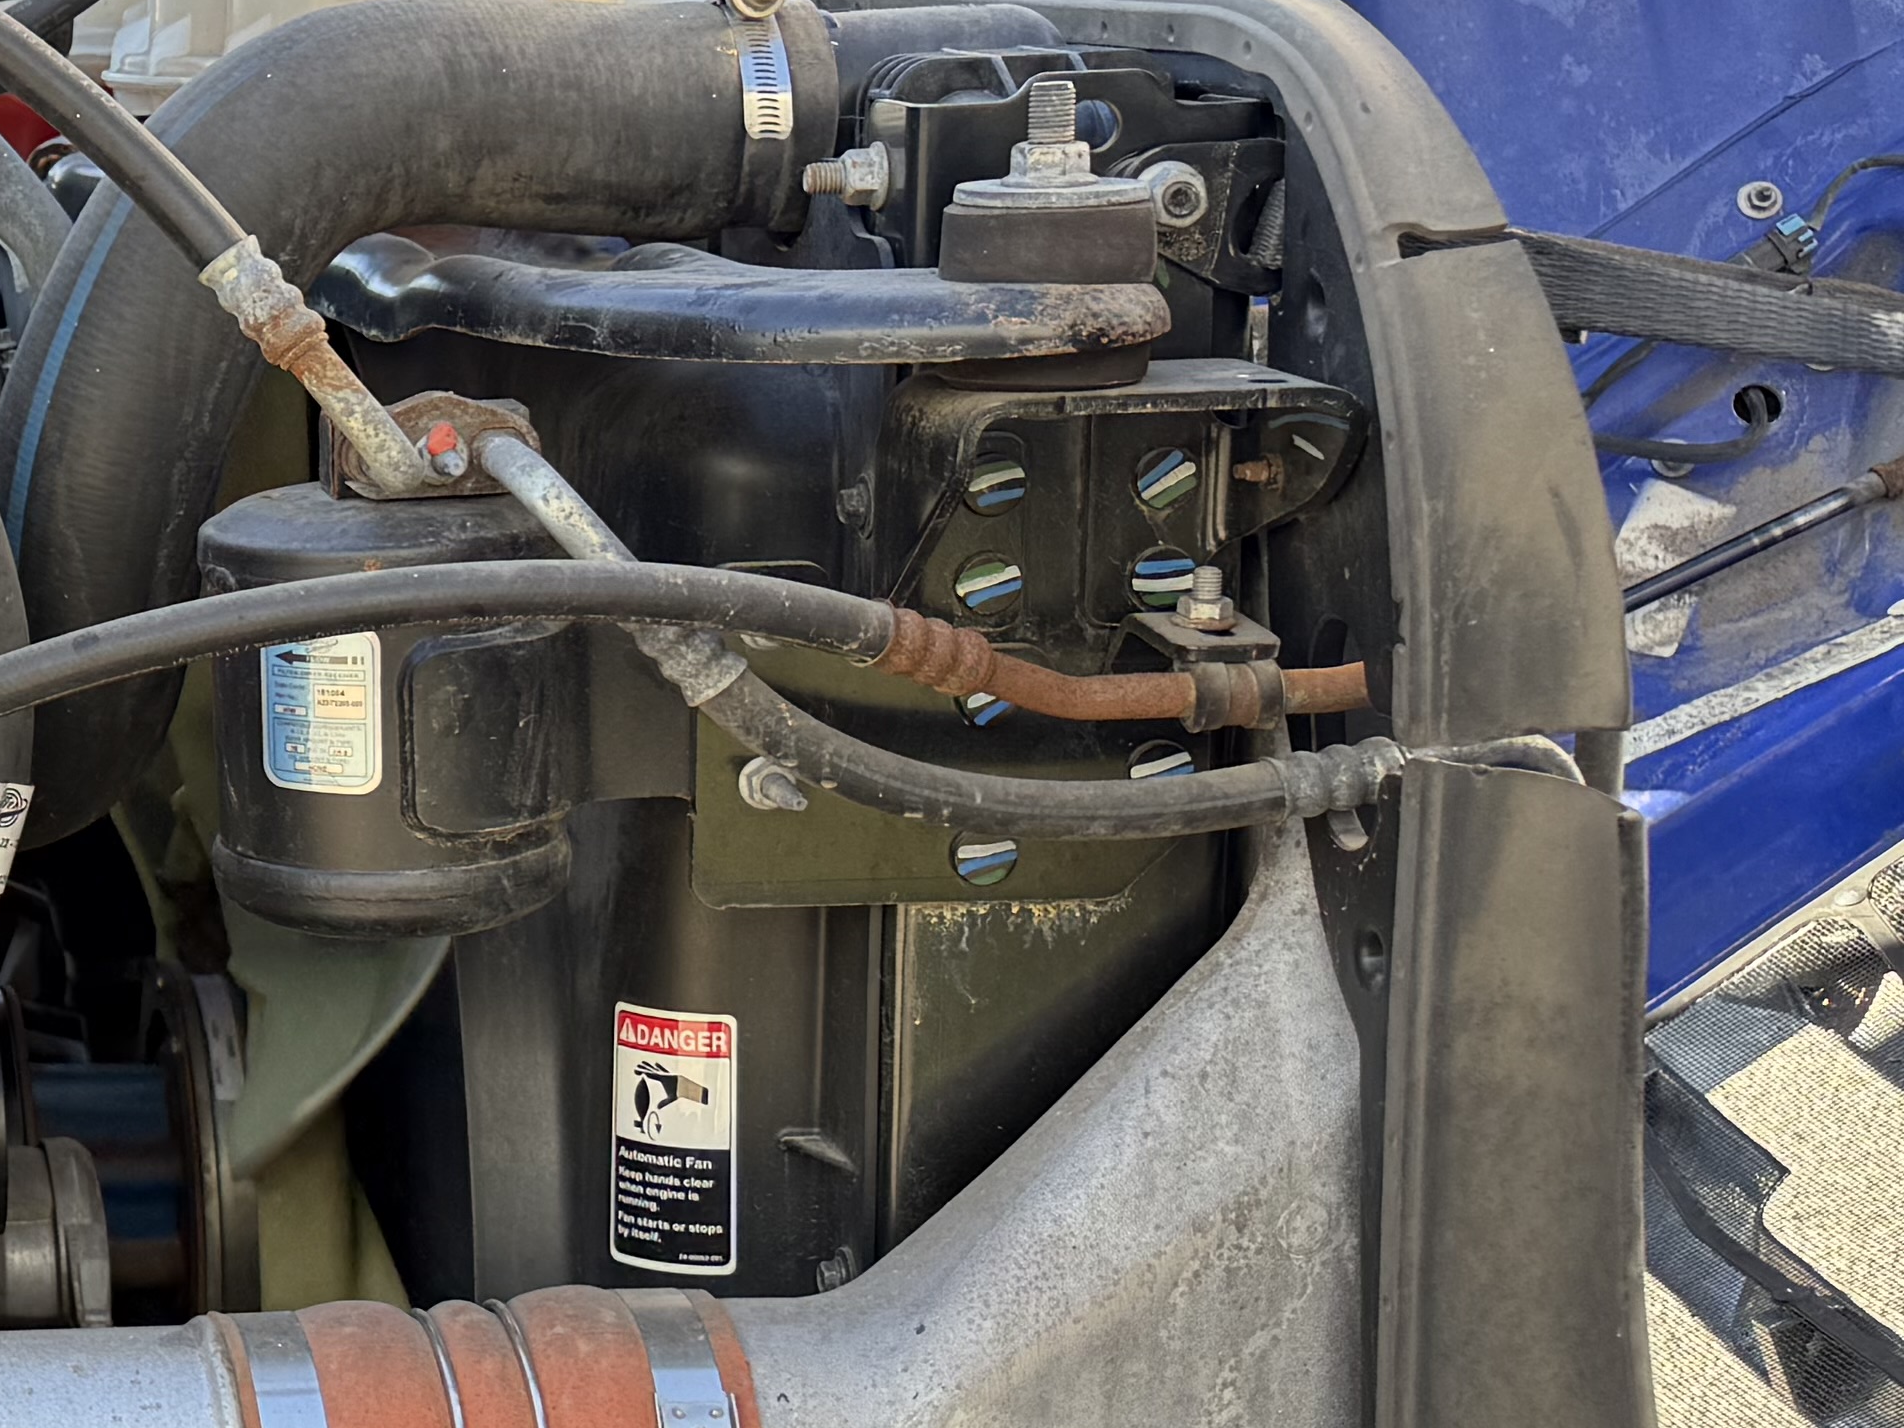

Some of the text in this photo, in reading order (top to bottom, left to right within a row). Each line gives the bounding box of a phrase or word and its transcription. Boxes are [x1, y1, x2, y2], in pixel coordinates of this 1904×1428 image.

[637, 1027, 728, 1053] DANGER
[618, 1145, 713, 1170] Automatic Fan
[619, 1166, 714, 1189] Keep hands clear
[618, 1182, 700, 1202] when engine is
[618, 1194, 660, 1212] running.
[618, 1211, 723, 1236] Fan starts or stops
[631, 1228, 662, 1244] itself.
